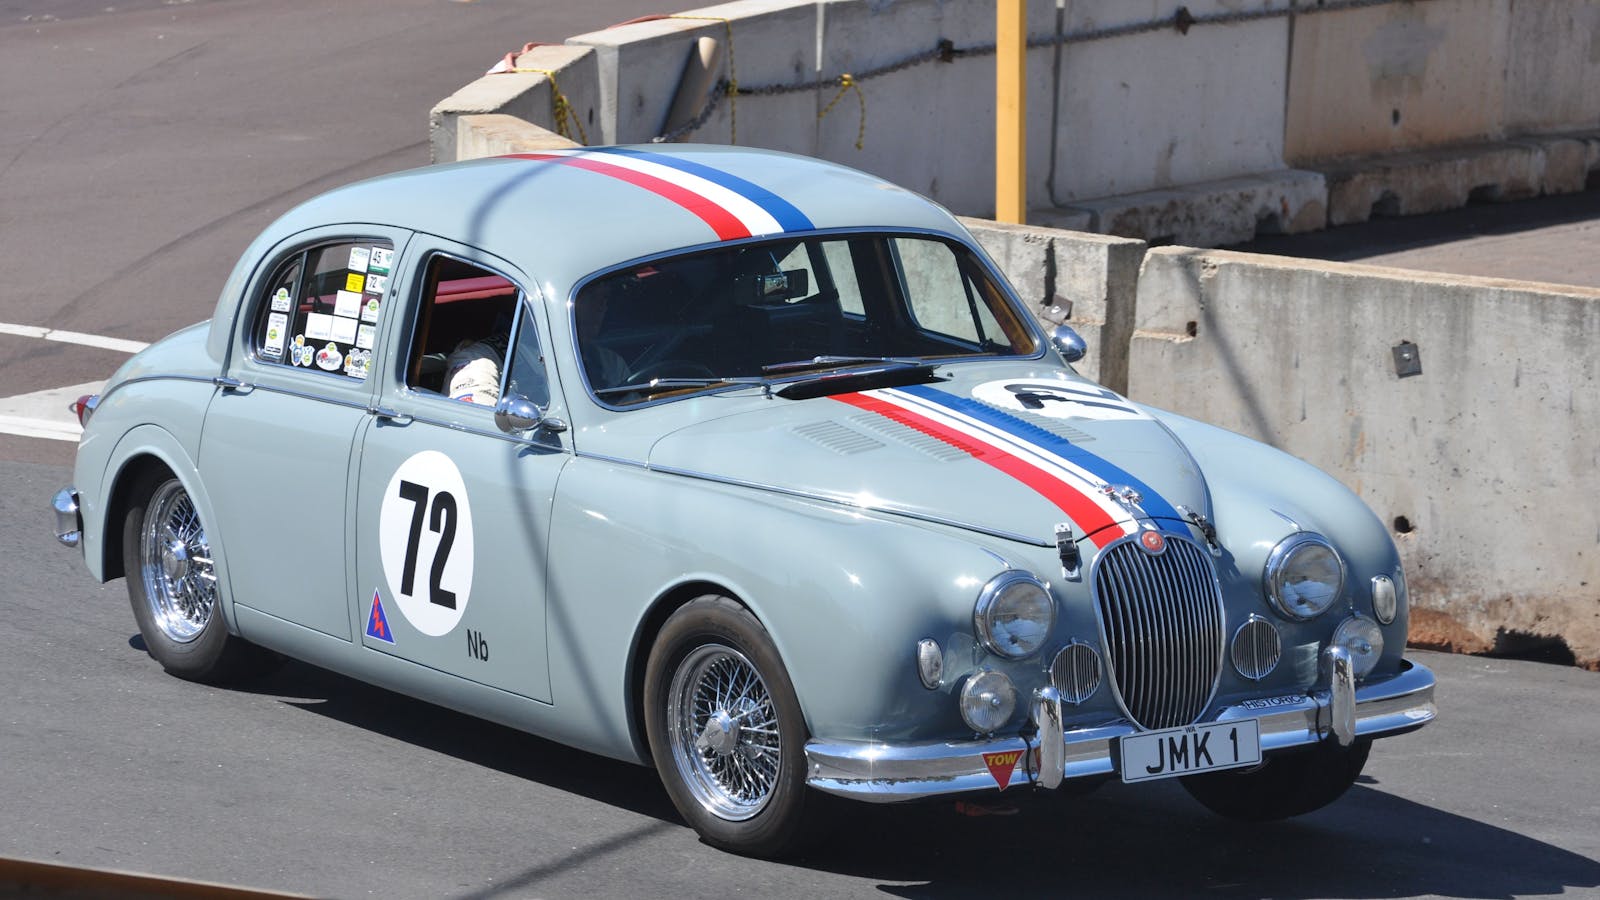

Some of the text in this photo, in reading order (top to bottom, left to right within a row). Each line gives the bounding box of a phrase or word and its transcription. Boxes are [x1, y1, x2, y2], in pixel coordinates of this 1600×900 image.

[399, 479, 458, 610] 72
[467, 629, 488, 661] Nb
[1243, 695, 1305, 710] HISTORIC
[986, 752, 1018, 767] TOW
[1146, 727, 1239, 774] JMK 1
